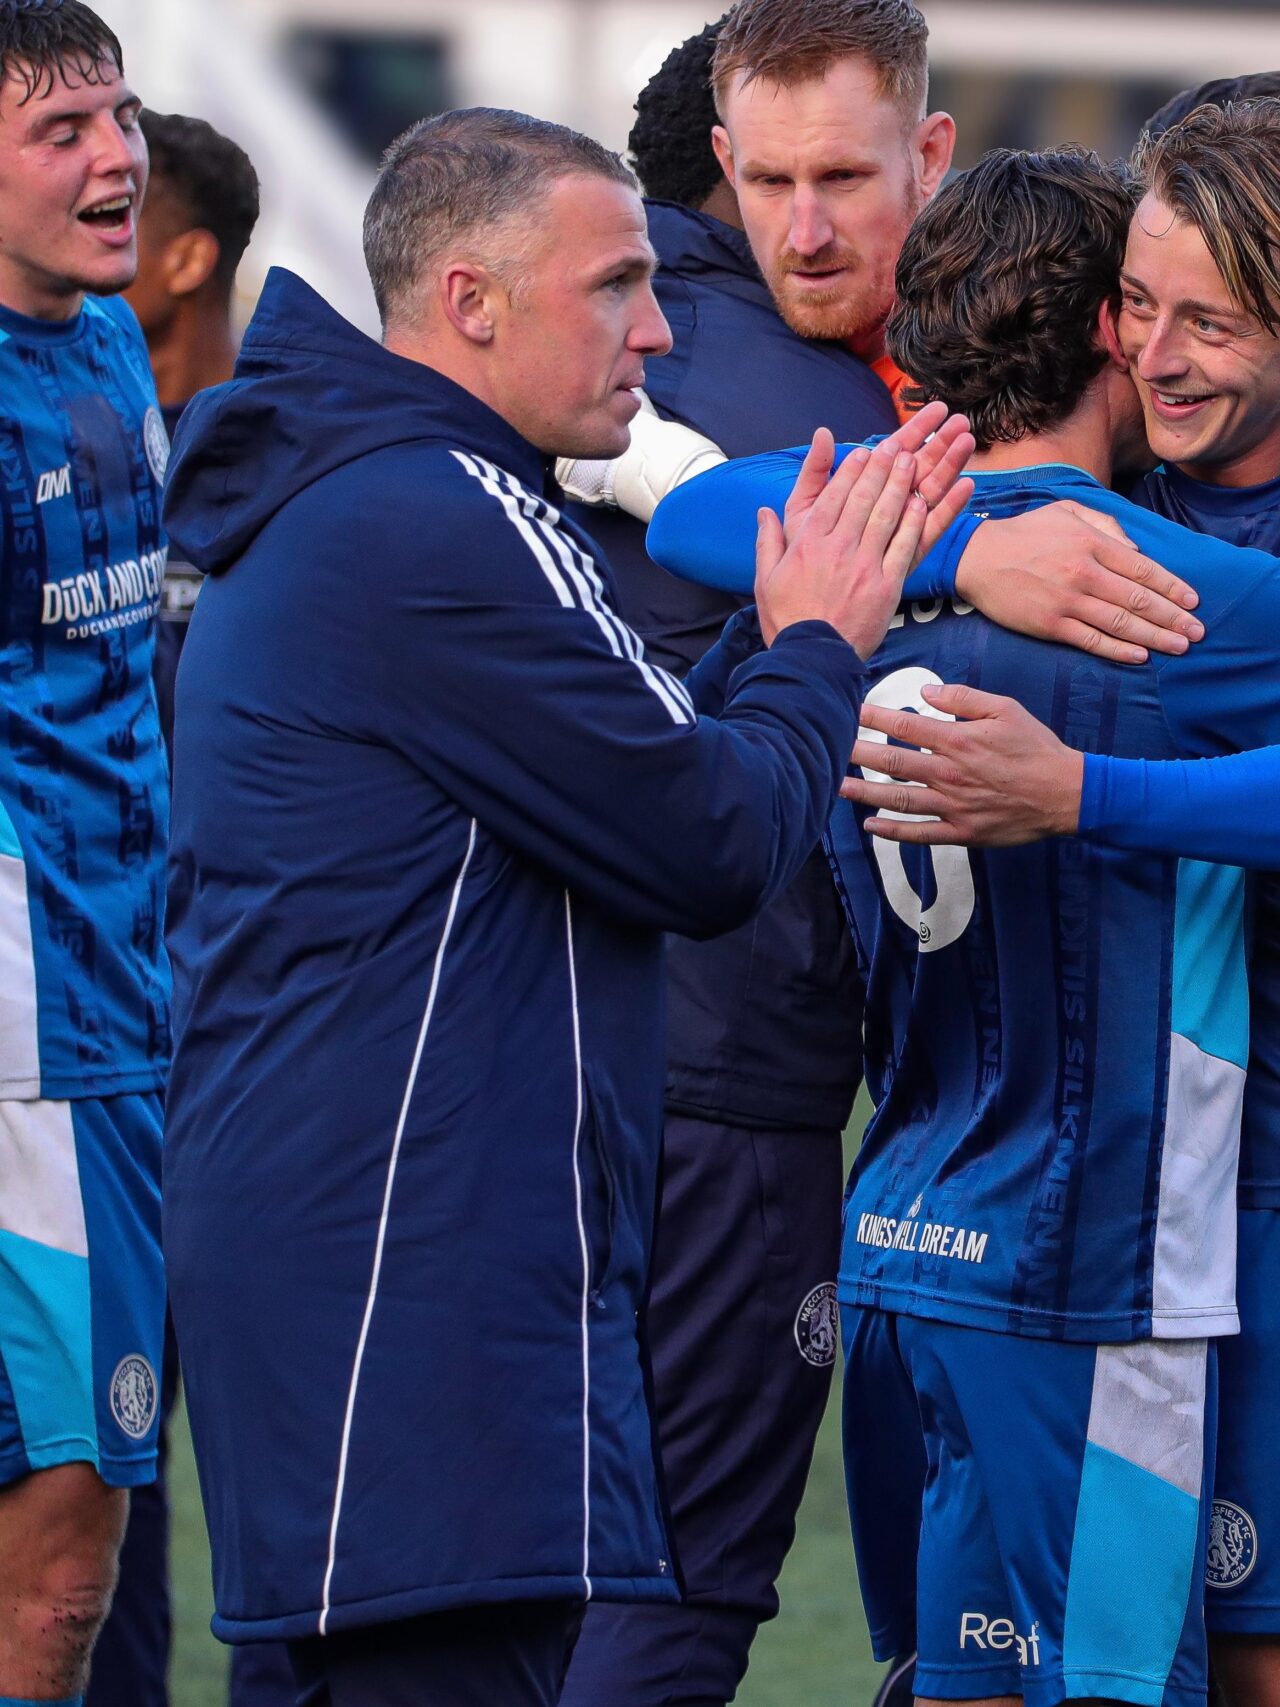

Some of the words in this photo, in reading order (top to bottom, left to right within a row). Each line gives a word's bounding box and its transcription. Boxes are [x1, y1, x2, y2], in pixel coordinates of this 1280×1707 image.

[106, 560, 144, 611] AND
[856, 1212, 896, 1250] KINGS
[918, 1223, 989, 1264] DREAM
[1229, 1562, 1246, 1580] 1874
